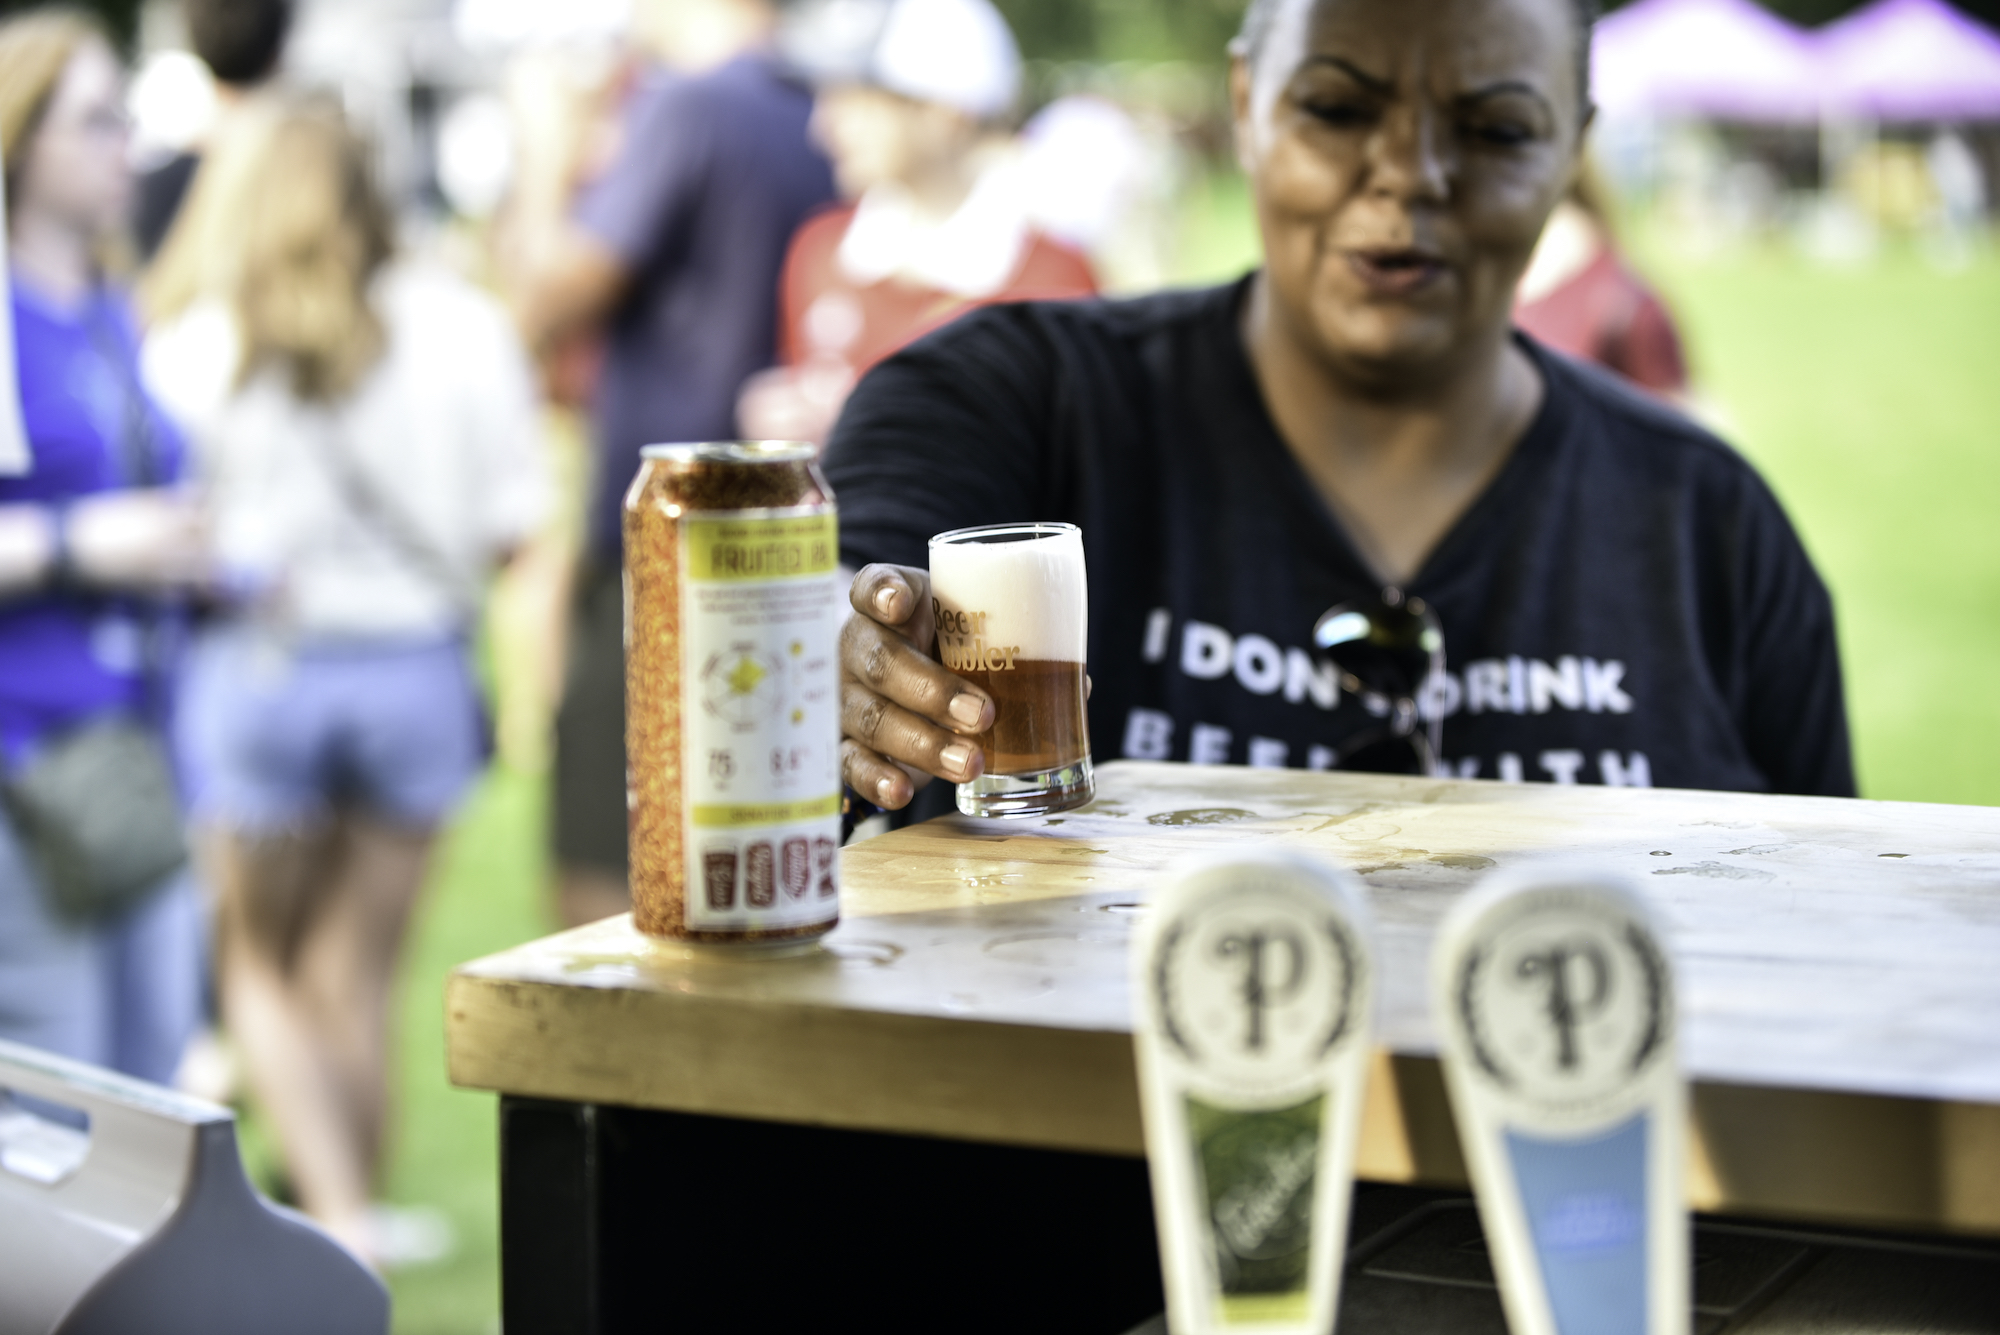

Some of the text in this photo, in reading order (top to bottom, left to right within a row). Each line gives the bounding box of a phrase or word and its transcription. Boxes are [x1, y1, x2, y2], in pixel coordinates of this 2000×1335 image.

[711, 541, 803, 577] FRUITED
[932, 597, 986, 634] Beer
[942, 636, 1020, 671] bbler
[1144, 608, 1171, 662] I
[1180, 620, 1390, 717] DON
